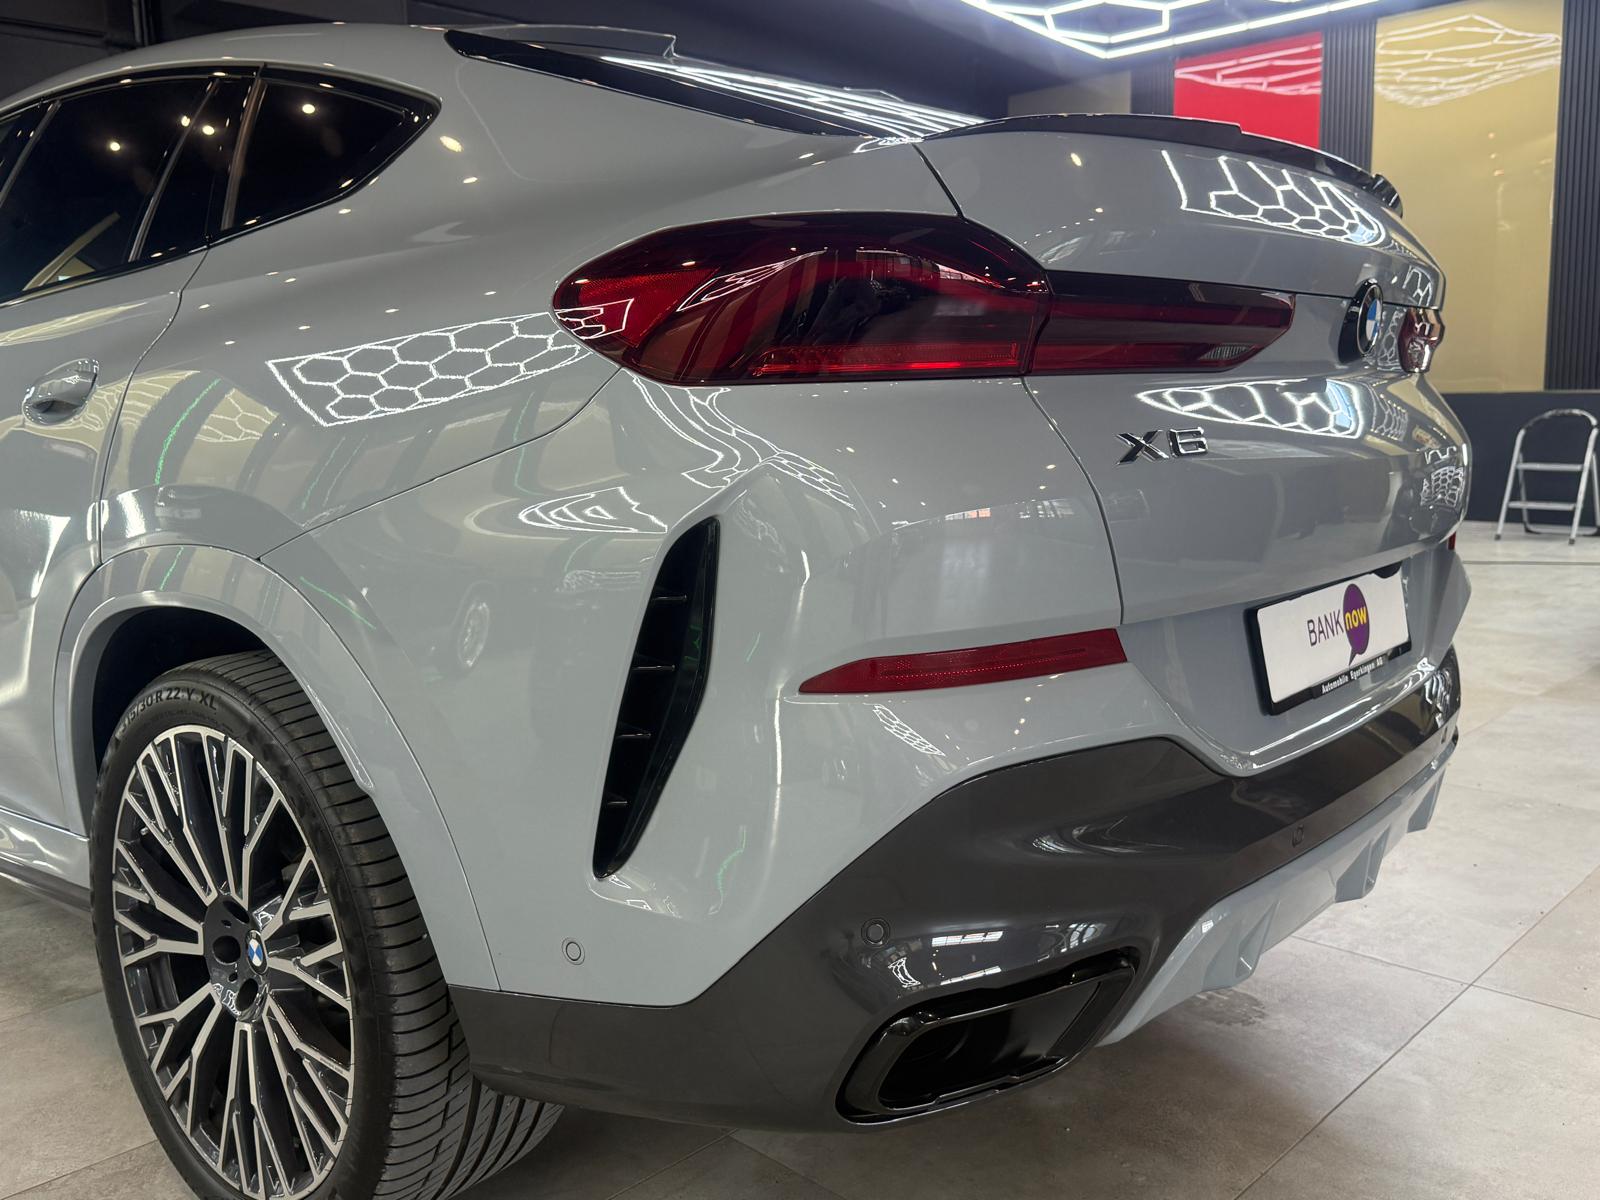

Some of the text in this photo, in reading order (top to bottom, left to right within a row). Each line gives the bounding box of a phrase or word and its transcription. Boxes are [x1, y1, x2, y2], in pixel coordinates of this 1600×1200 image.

[1115, 426, 1208, 466] X6
[1307, 607, 1367, 647] BANK now
[1321, 656, 1384, 694] Automobile Egerkingen AG
[166, 687, 181, 701] 22
[199, 692, 218, 711] XL
